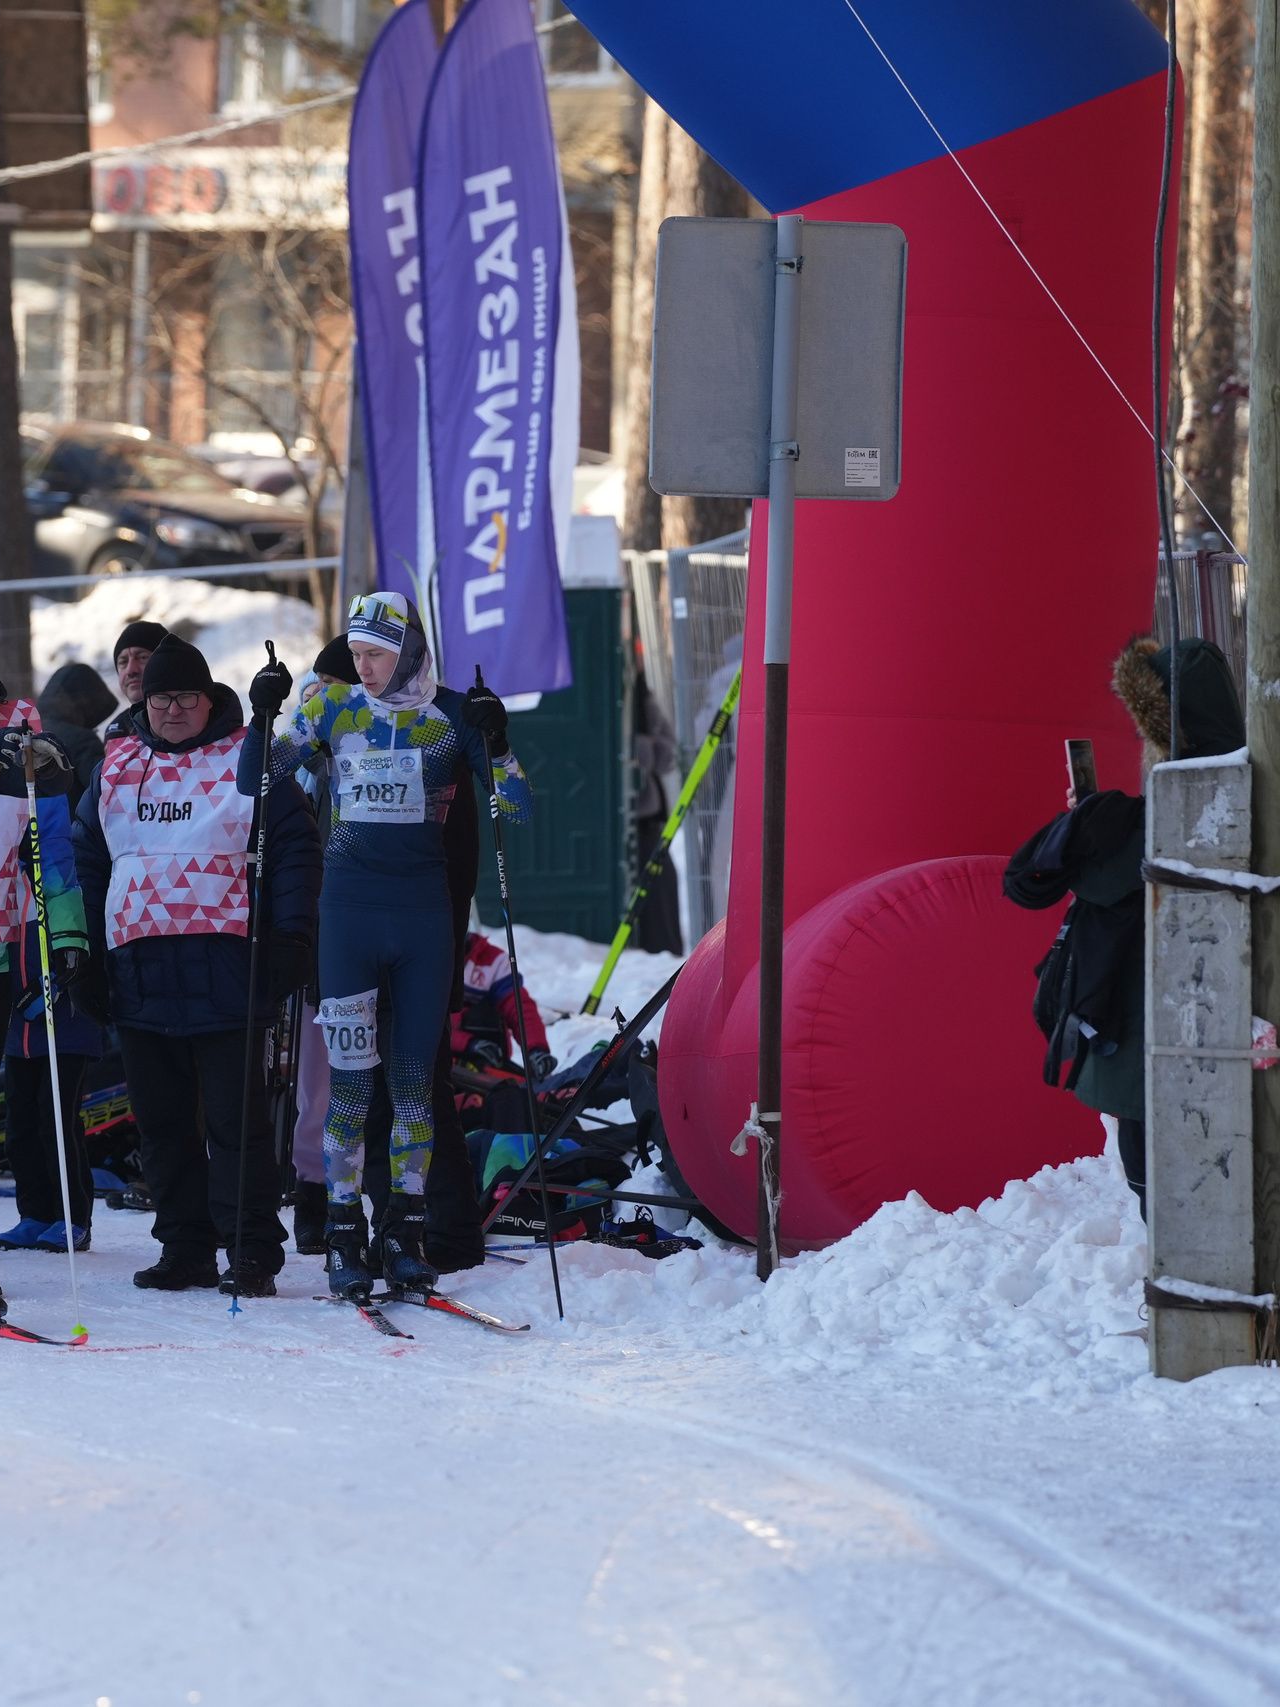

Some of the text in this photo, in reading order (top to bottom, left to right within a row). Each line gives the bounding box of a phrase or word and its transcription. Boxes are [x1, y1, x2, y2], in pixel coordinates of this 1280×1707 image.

[462, 164, 519, 635] ПАРМЕЗАН
[517, 246, 549, 532] Больше чем пицца
[139, 801, 193, 823] СУДЬЯ
[351, 783, 408, 804] 7087
[29, 816, 47, 930] ONEWAY
[256, 829, 265, 878] salomon
[496, 850, 508, 899] salomon
[600, 1037, 626, 1069] ATOMIC
